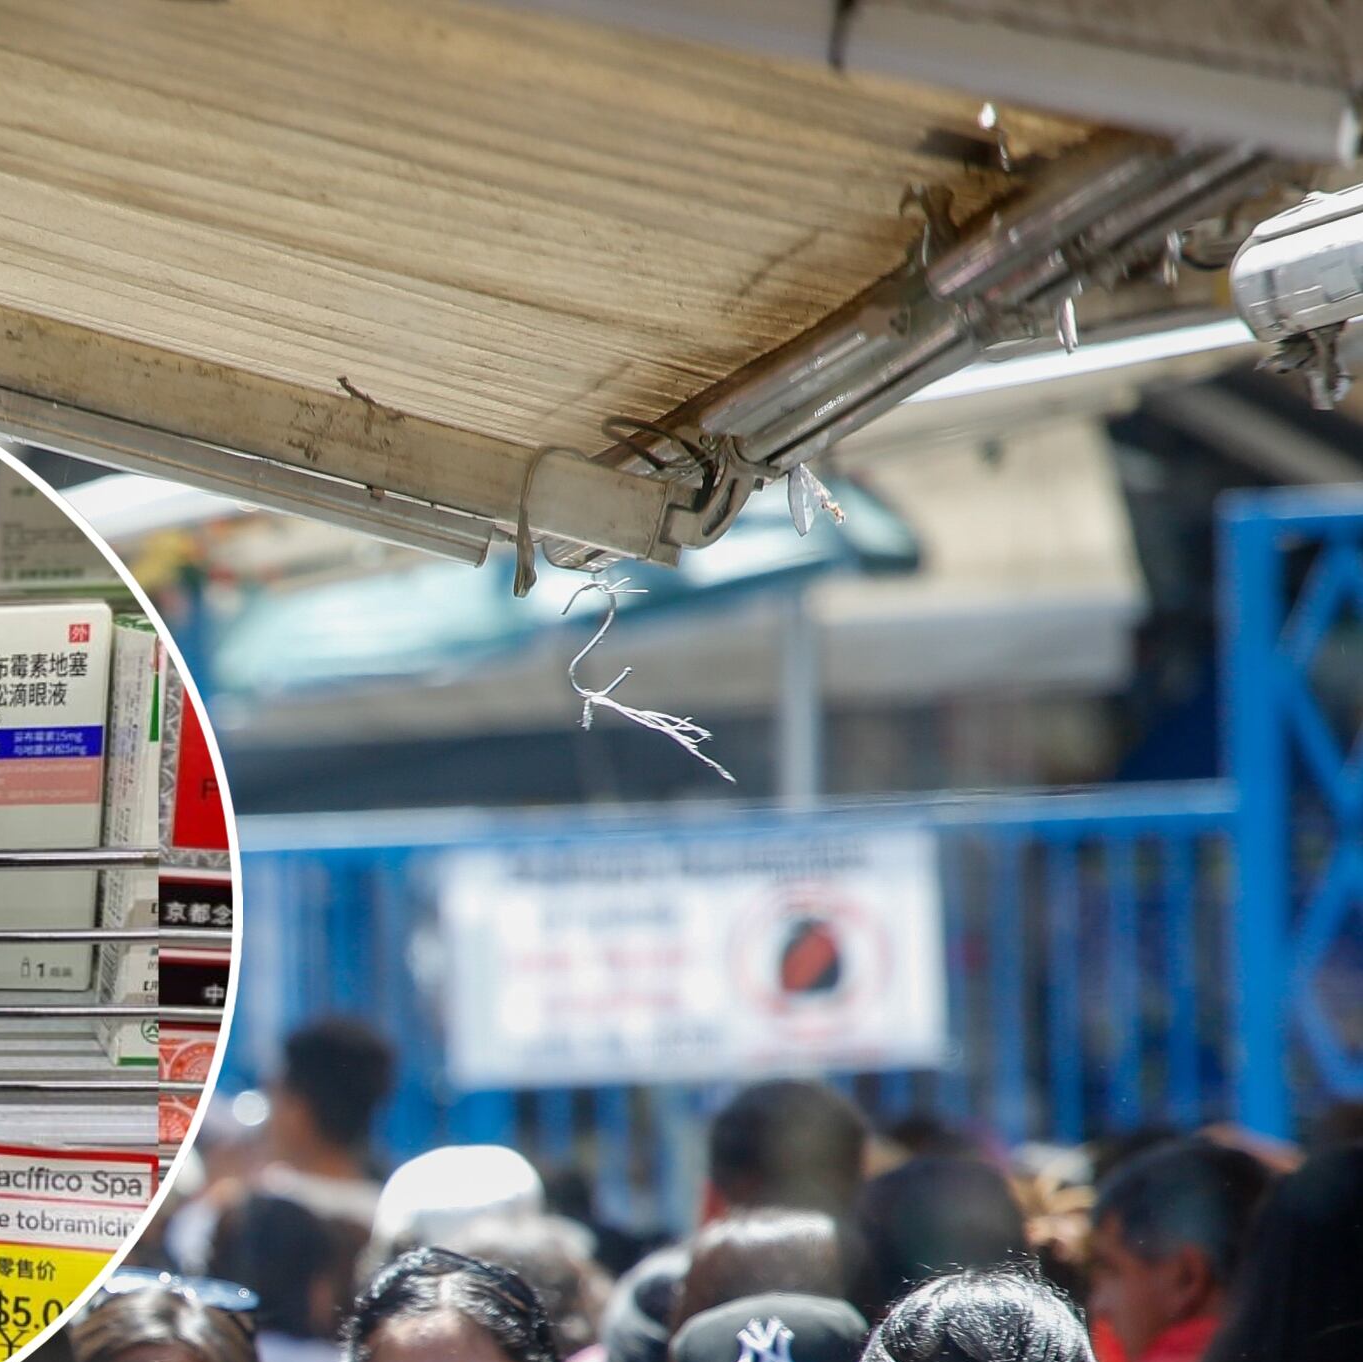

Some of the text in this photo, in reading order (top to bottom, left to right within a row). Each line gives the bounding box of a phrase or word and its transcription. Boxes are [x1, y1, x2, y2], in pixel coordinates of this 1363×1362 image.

[70, 624, 90, 643] 外
[38, 963, 45, 977] 1
[90, 1170, 142, 1199] Spa
